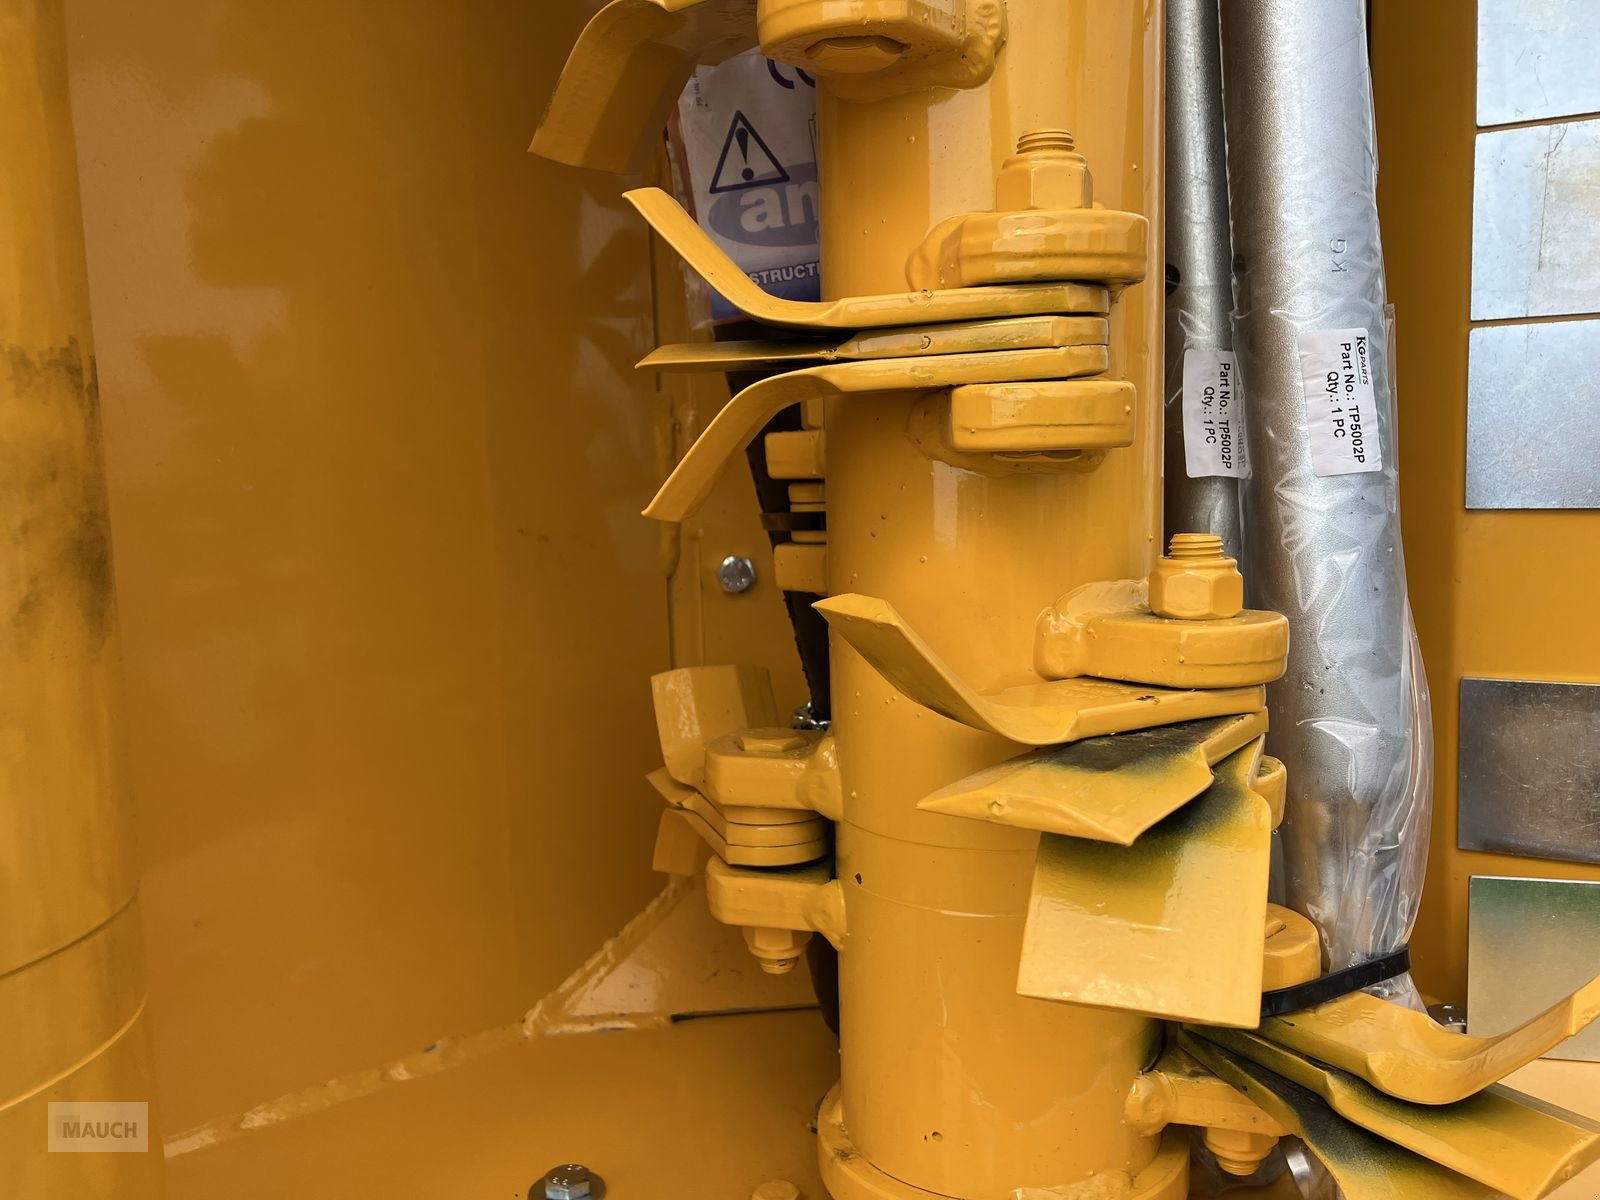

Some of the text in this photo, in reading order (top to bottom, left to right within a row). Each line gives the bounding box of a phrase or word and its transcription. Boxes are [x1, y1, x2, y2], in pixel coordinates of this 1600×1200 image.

[1201, 386, 1215, 414] Qty.:
[1218, 362, 1232, 469] Part No.: TP5002P
[1326, 371, 1346, 438] Qty.: 1 PC
[1340, 343, 1365, 464] Part No.: TP5002P
[1204, 427, 1217, 444] PC
